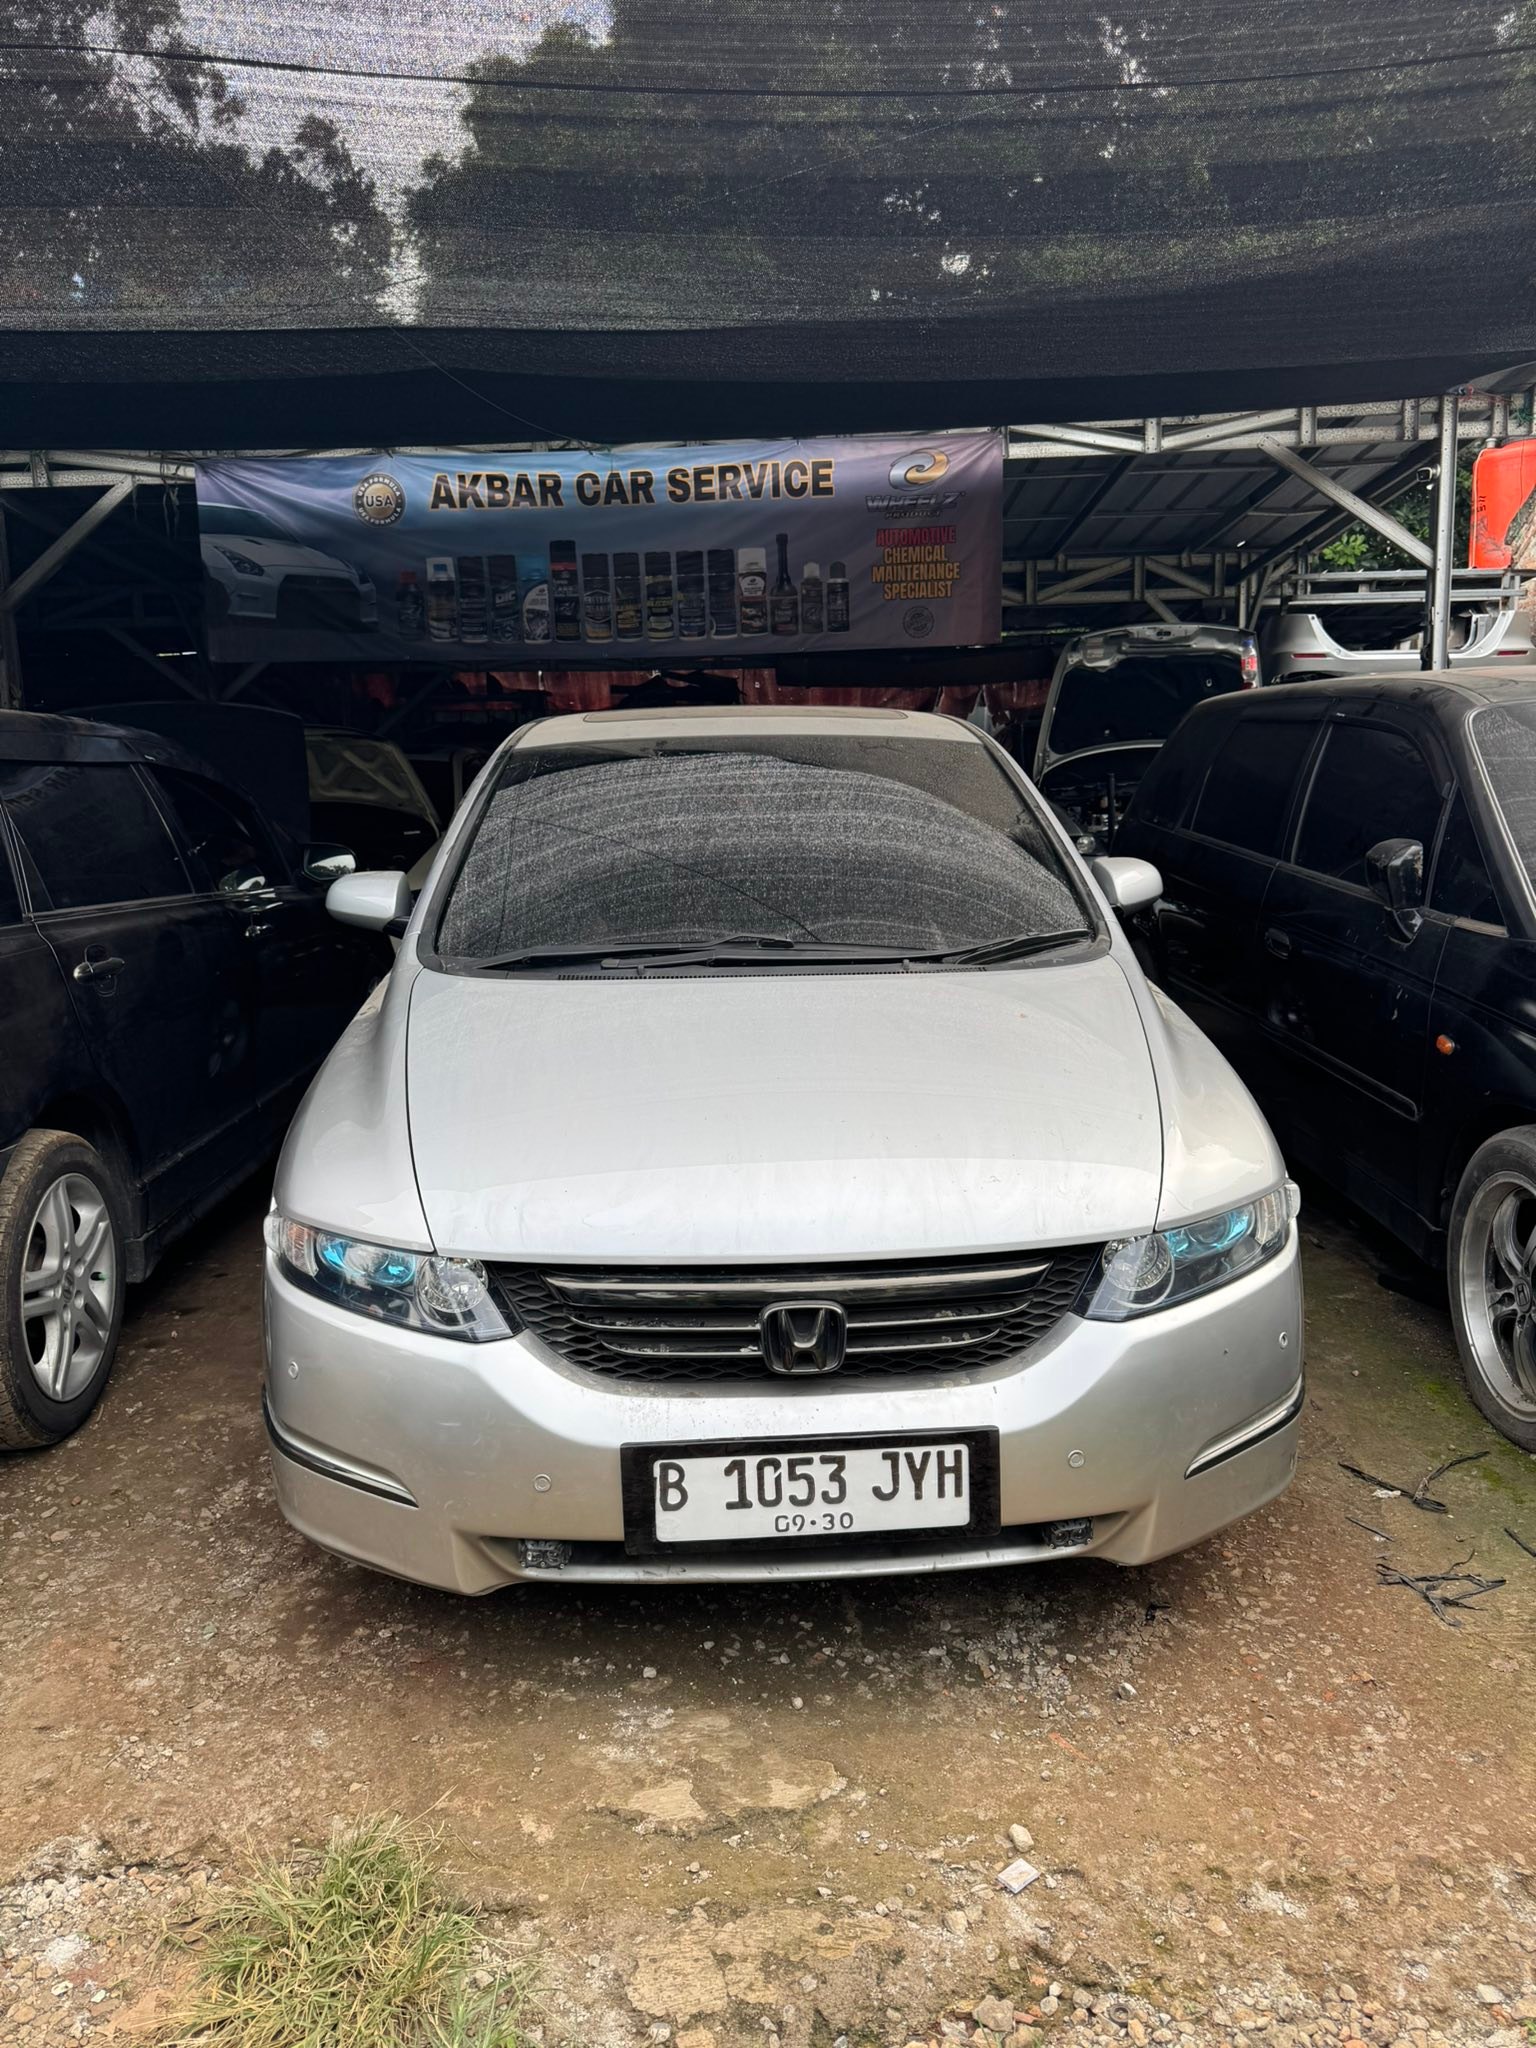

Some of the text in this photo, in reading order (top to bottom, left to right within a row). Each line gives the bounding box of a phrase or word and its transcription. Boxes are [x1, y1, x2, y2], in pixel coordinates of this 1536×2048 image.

[357, 476, 401, 496] USA FORMULA
[430, 458, 836, 511] AKBAR CAR SERVICE
[365, 495, 394, 508] USA
[866, 491, 961, 513] WHEELZ
[370, 507, 402, 525] FORMULA
[884, 509, 942, 520] PRODUCT
[875, 526, 957, 547] AUTOMOTIVE
[883, 545, 948, 564] CHEMICAL
[872, 562, 962, 583] MAINTENANCE
[882, 580, 954, 600] SPECIALIST
[658, 1450, 964, 1512] B 1053 JYH
